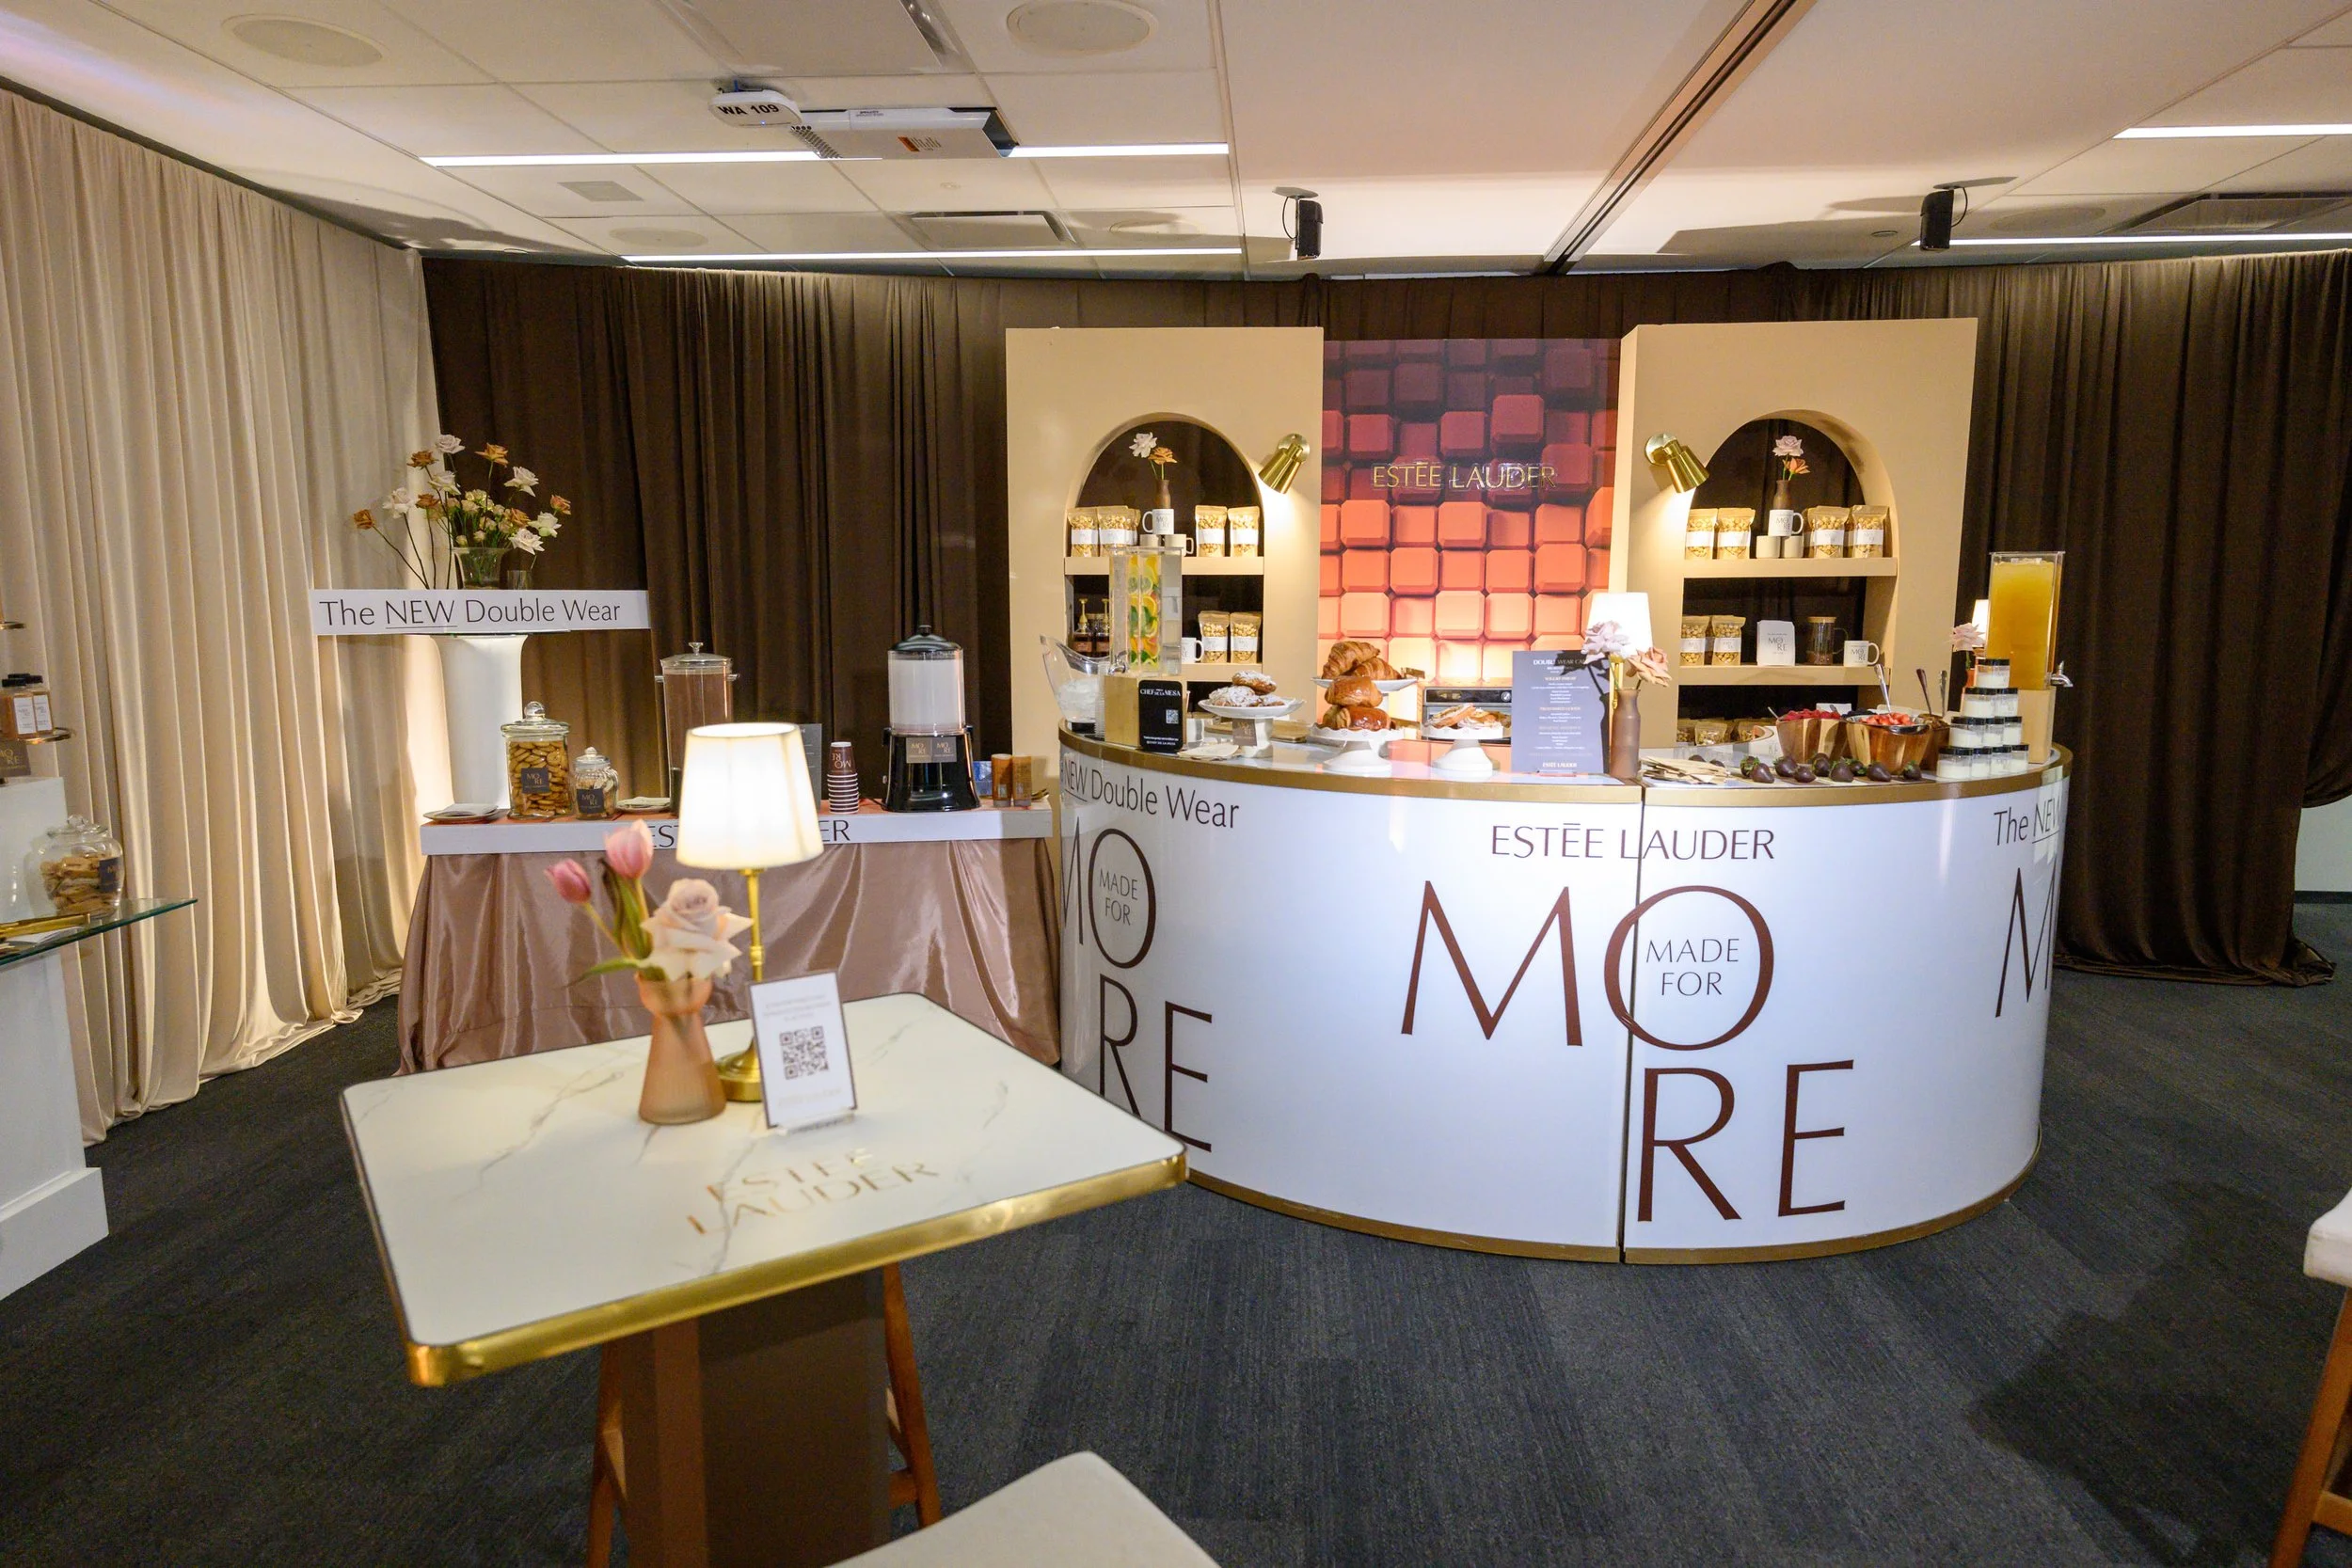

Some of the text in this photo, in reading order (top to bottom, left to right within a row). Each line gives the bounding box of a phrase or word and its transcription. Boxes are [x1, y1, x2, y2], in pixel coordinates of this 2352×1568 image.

[717, 103, 780, 115] WA 109
[1451, 465, 1557, 489] LAUDER
[319, 597, 621, 626] The NEW Double Wear
[1064, 758, 1240, 829] NEW Double Wear
[1994, 805, 2029, 846] The
[1619, 828, 1775, 861] LAUDER
[1099, 867, 1138, 901] MADE
[1104, 896, 1131, 927] FOR
[1400, 879, 1775, 1052] MO
[1645, 938, 1740, 964] MADE
[1661, 971, 1724, 997] FOR
[1099, 973, 1213, 1153] RE
[1637, 1059, 1854, 1223] RE
